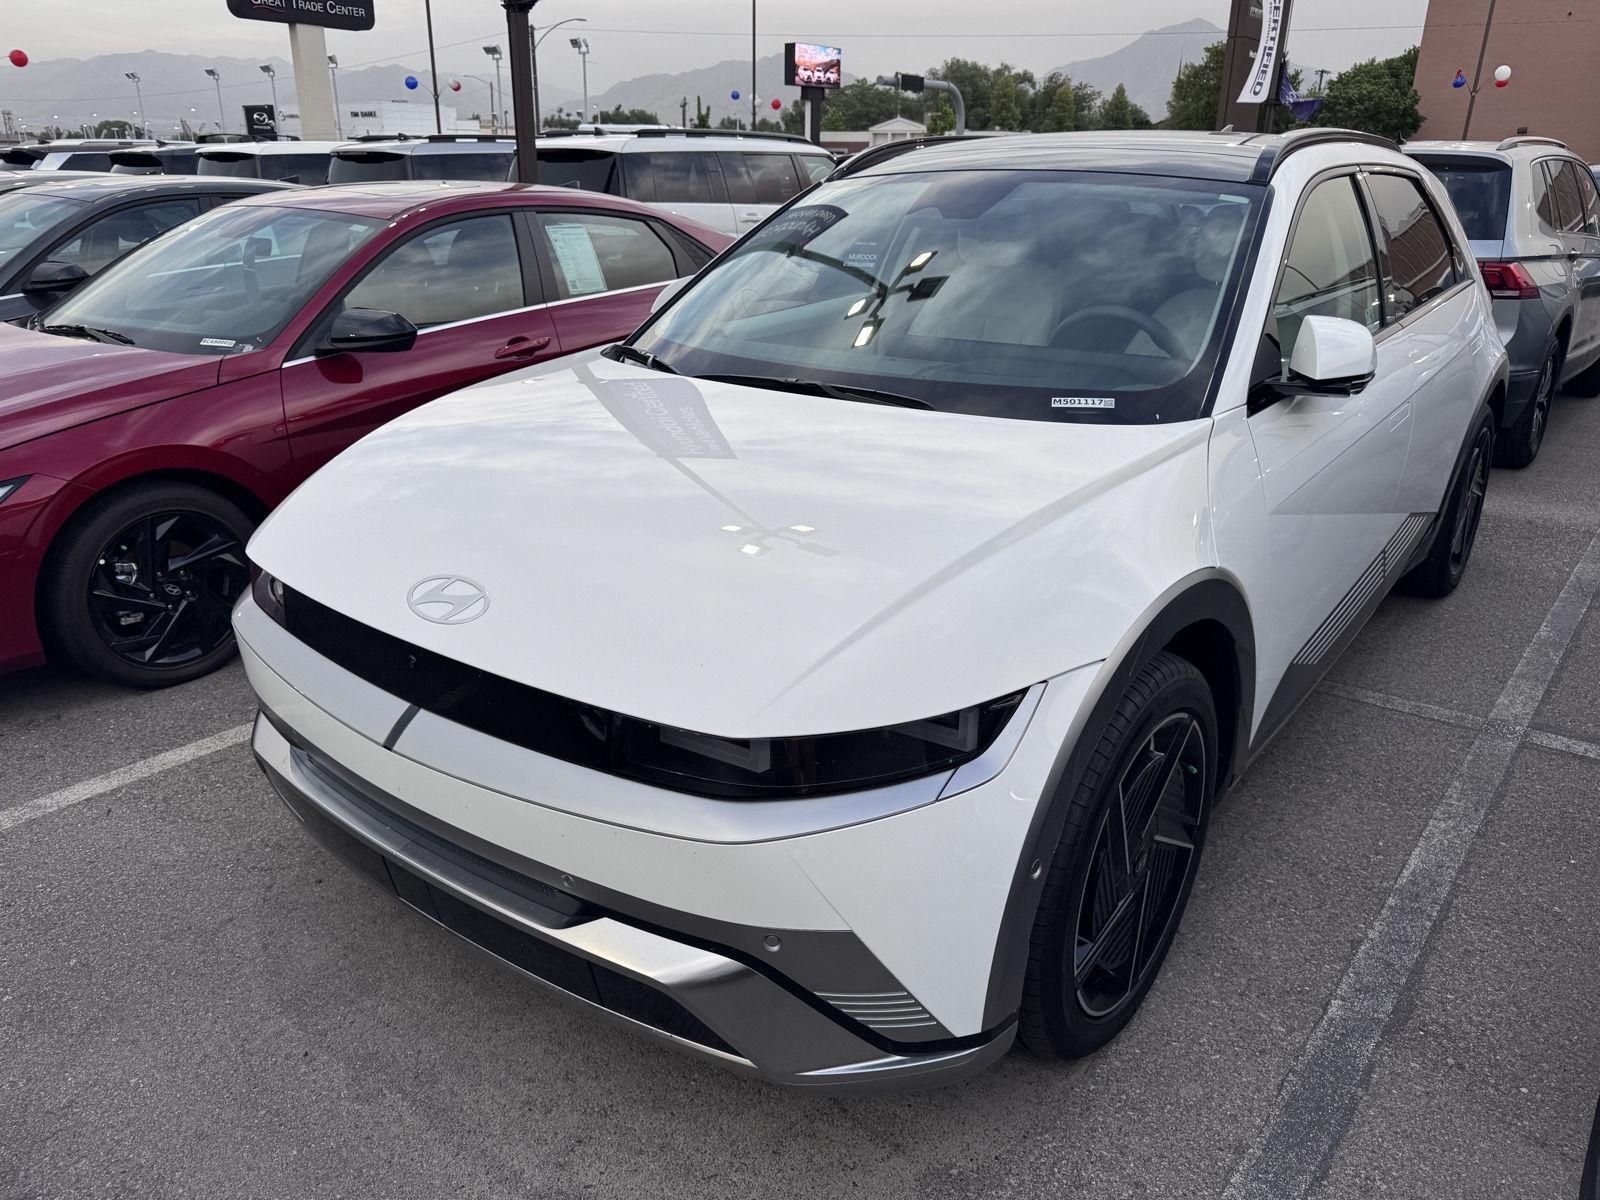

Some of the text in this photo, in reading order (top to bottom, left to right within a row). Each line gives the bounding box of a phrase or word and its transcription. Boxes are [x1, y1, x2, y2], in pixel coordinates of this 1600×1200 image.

[292, 0, 324, 12] TRADE
[327, 1, 366, 17] CENTER
[1053, 398, 1103, 406] M501117
